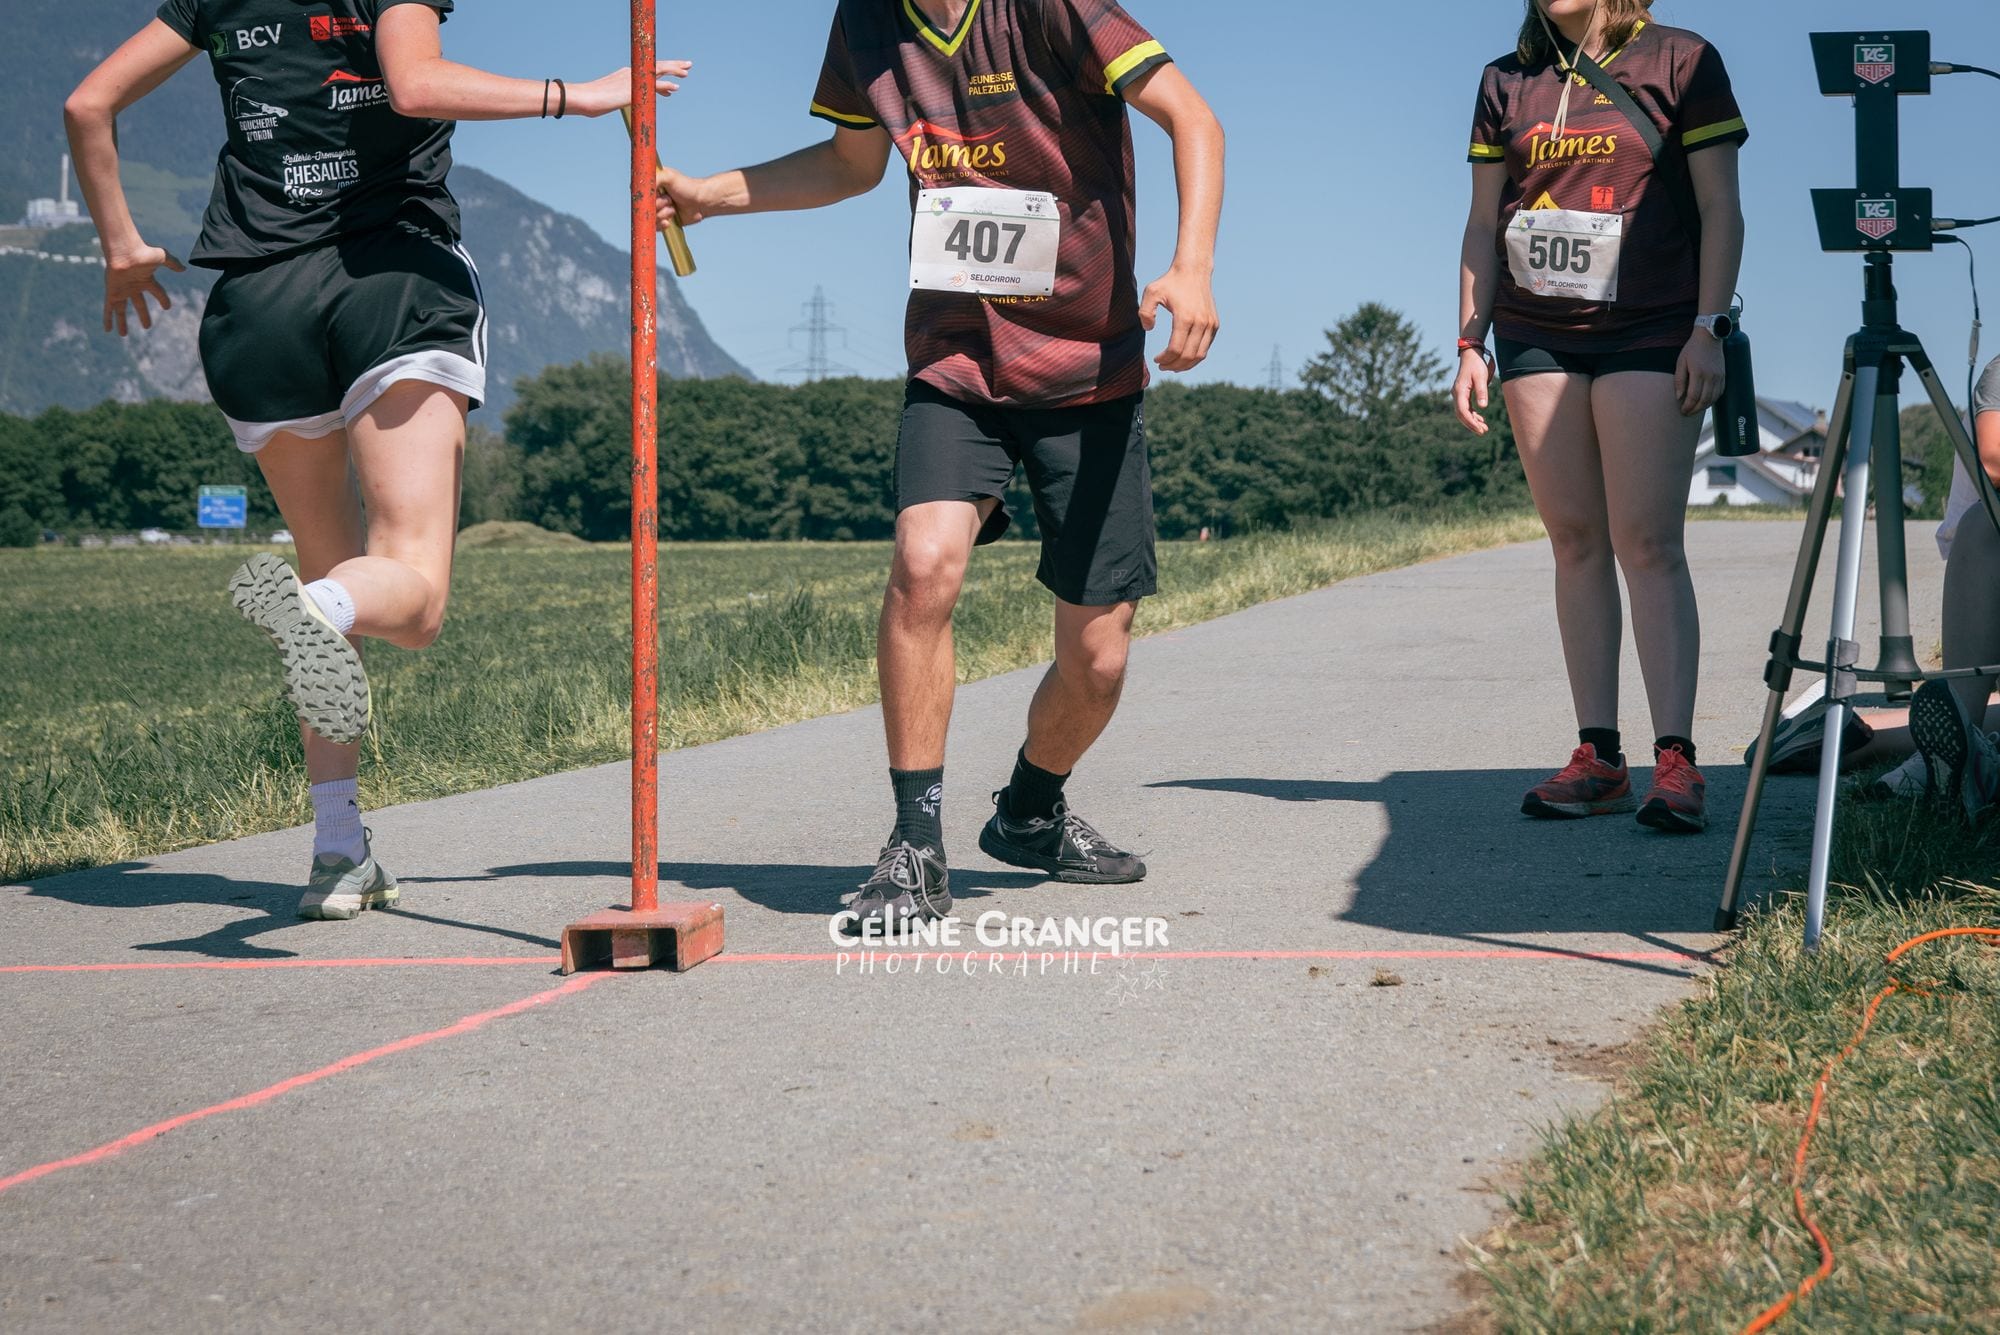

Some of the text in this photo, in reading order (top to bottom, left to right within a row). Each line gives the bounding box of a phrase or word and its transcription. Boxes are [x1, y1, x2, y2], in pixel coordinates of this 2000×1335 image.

[236, 23, 282, 50] BCV
[1861, 47, 1889, 62] TAG
[970, 71, 1014, 85] JEUNESSE
[1857, 65, 1892, 80] HEUER
[968, 82, 1017, 96] PALEZIEUX
[239, 117, 278, 131] BOUCHERIE
[909, 136, 1006, 173] James
[1526, 135, 1618, 169] James
[284, 160, 360, 185] CHESALLES
[1862, 202, 1890, 218] TAG
[1859, 220, 1894, 236] HEUER
[944, 219, 1026, 264] 407
[1528, 235, 1591, 273] 505
[970, 273, 1021, 284] SELOCHRONO
[1547, 280, 1588, 290] SELOCHRONO
